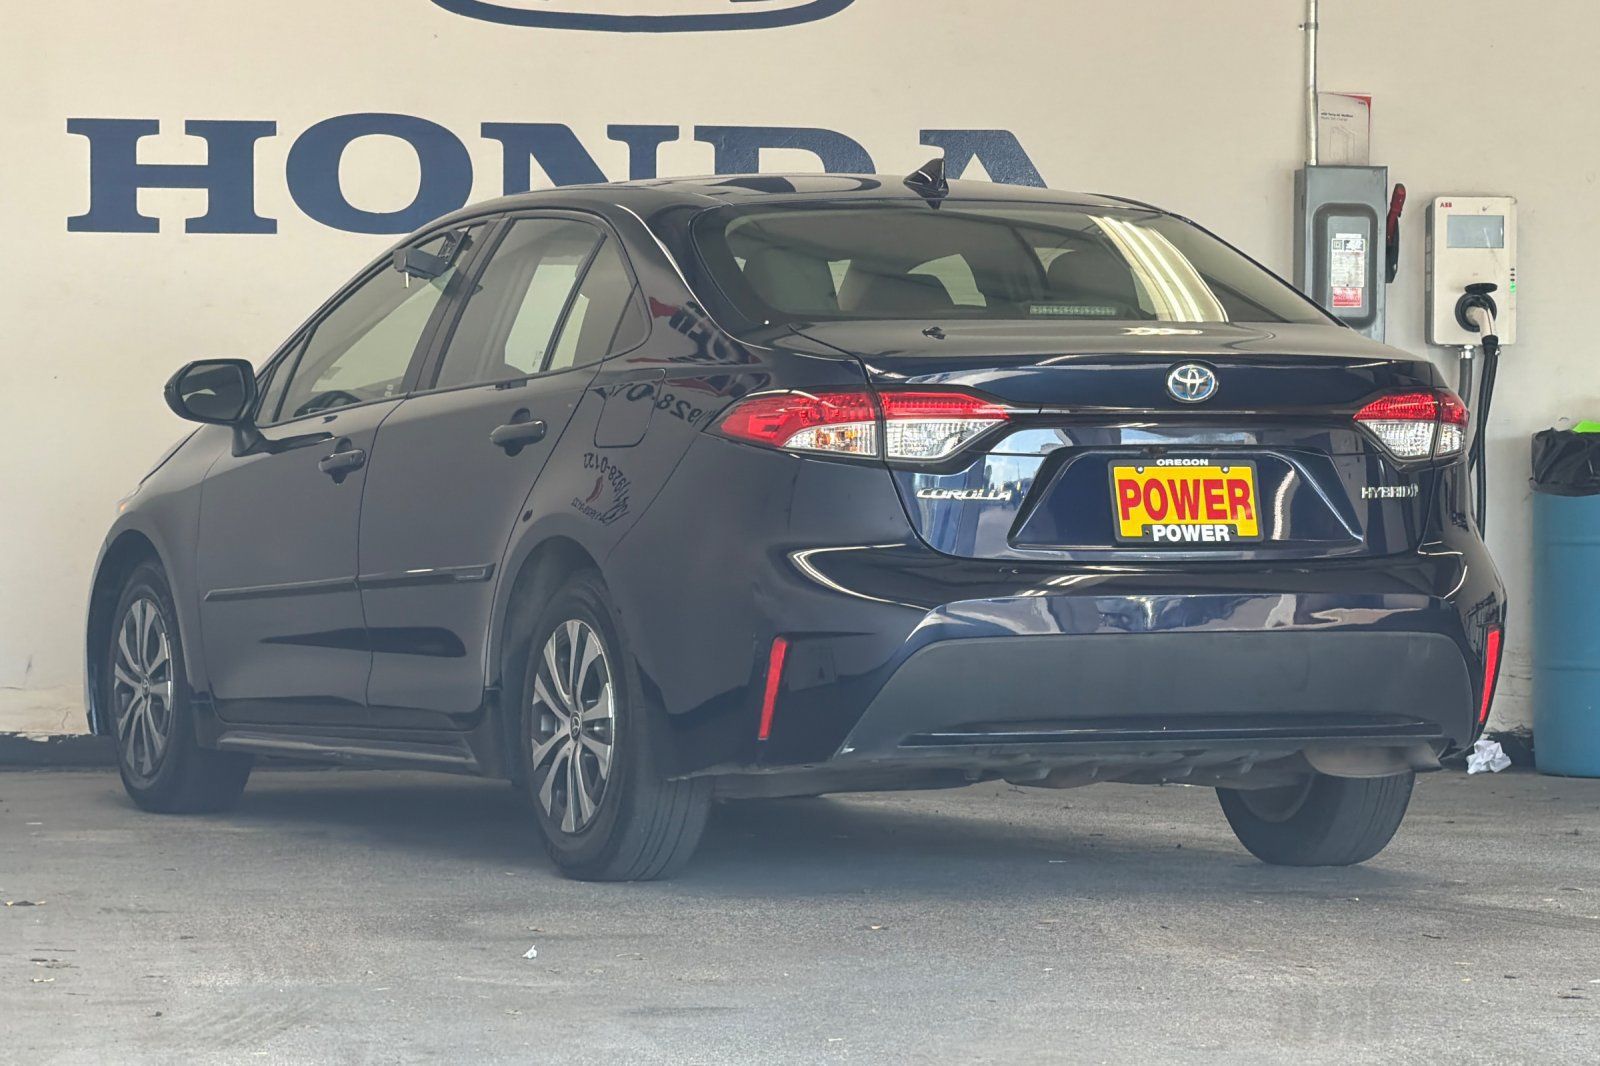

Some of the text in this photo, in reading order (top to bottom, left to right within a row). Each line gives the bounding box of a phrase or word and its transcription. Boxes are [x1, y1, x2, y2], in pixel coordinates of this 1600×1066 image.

[1156, 458, 1209, 466] OREGON
[917, 486, 1012, 501] COROLLA
[1118, 478, 1253, 521] POWER
[1361, 485, 1411, 499] HYBRID
[1152, 524, 1231, 542] POWER
